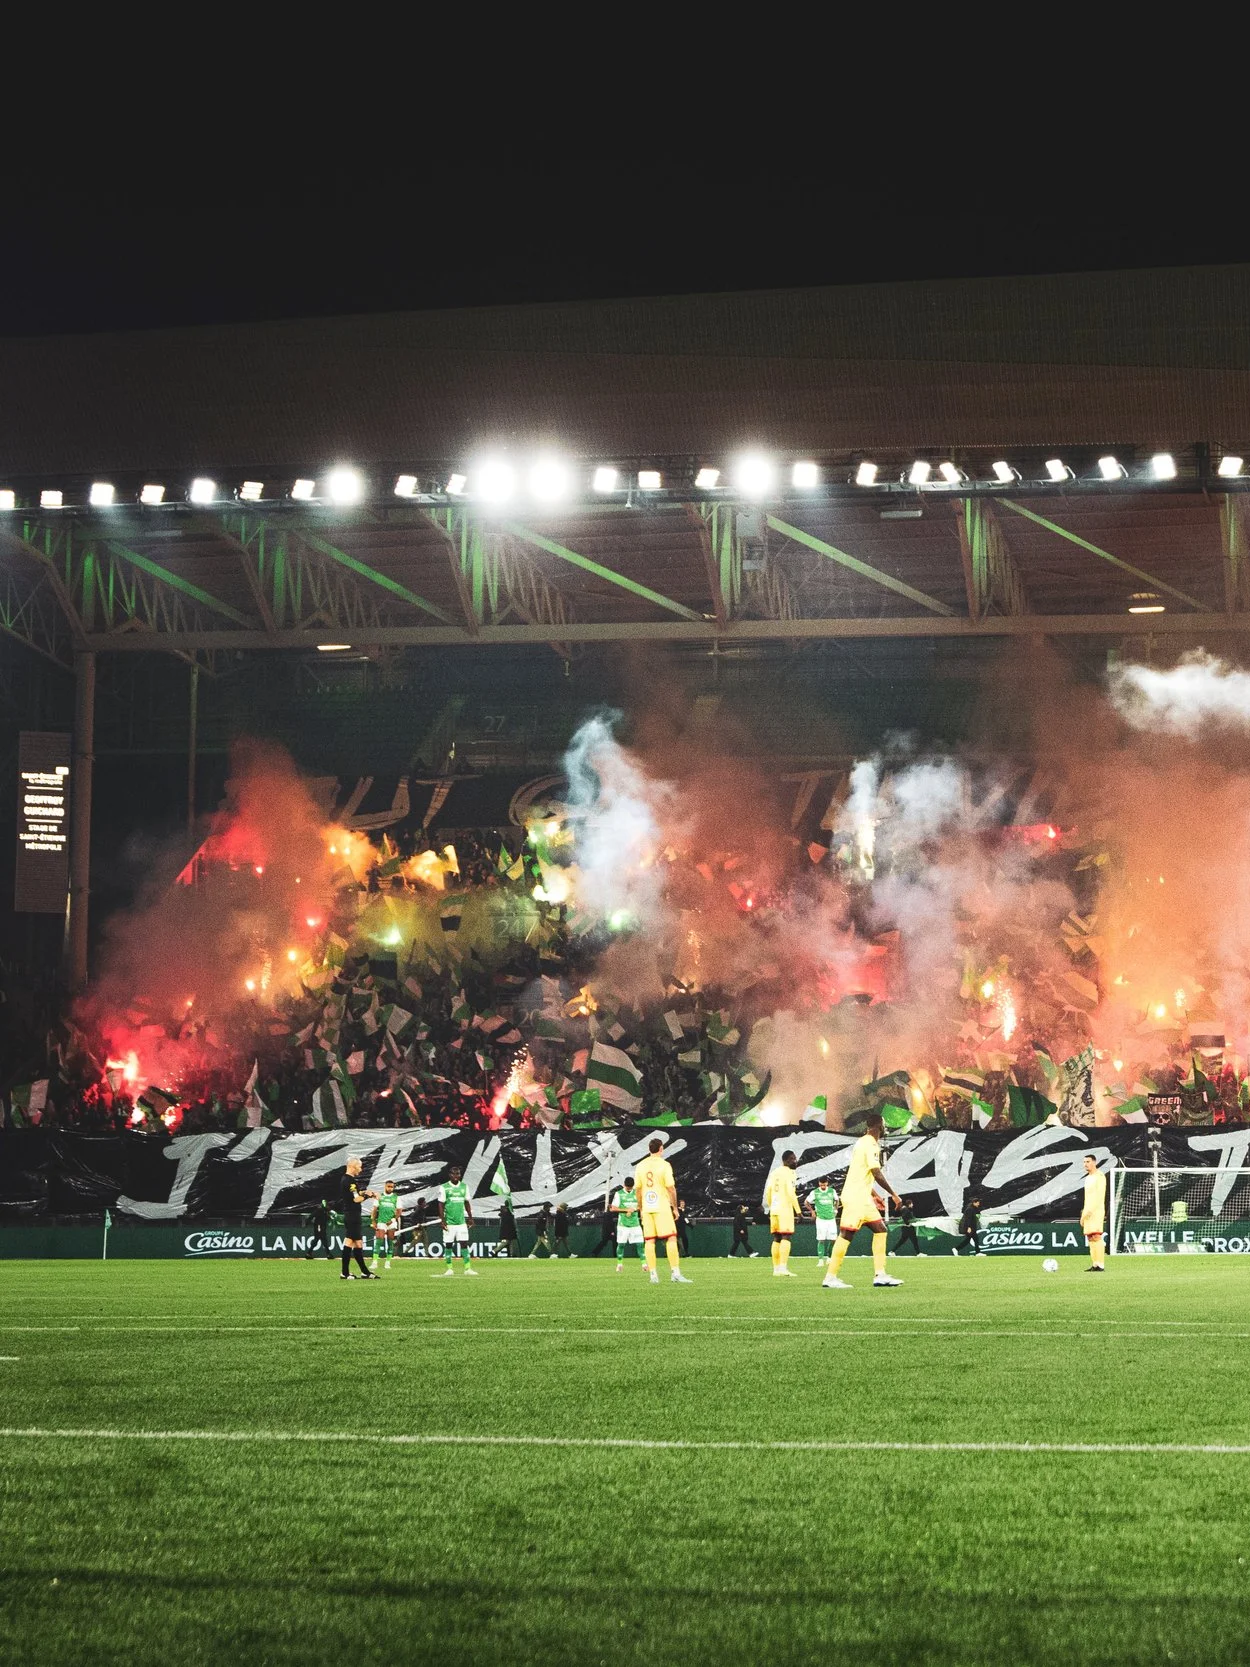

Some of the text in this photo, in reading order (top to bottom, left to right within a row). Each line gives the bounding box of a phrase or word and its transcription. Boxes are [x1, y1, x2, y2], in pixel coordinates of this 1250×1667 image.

[116, 1126, 687, 1219] J'PEUX
[762, 1123, 1118, 1218] PAS
[646, 1171, 654, 1188] 8
[184, 1231, 253, 1252] Casino
[261, 1236, 288, 1251] LA
[970, 1228, 1044, 1248] Casino
[1051, 1232, 1079, 1247] LA
